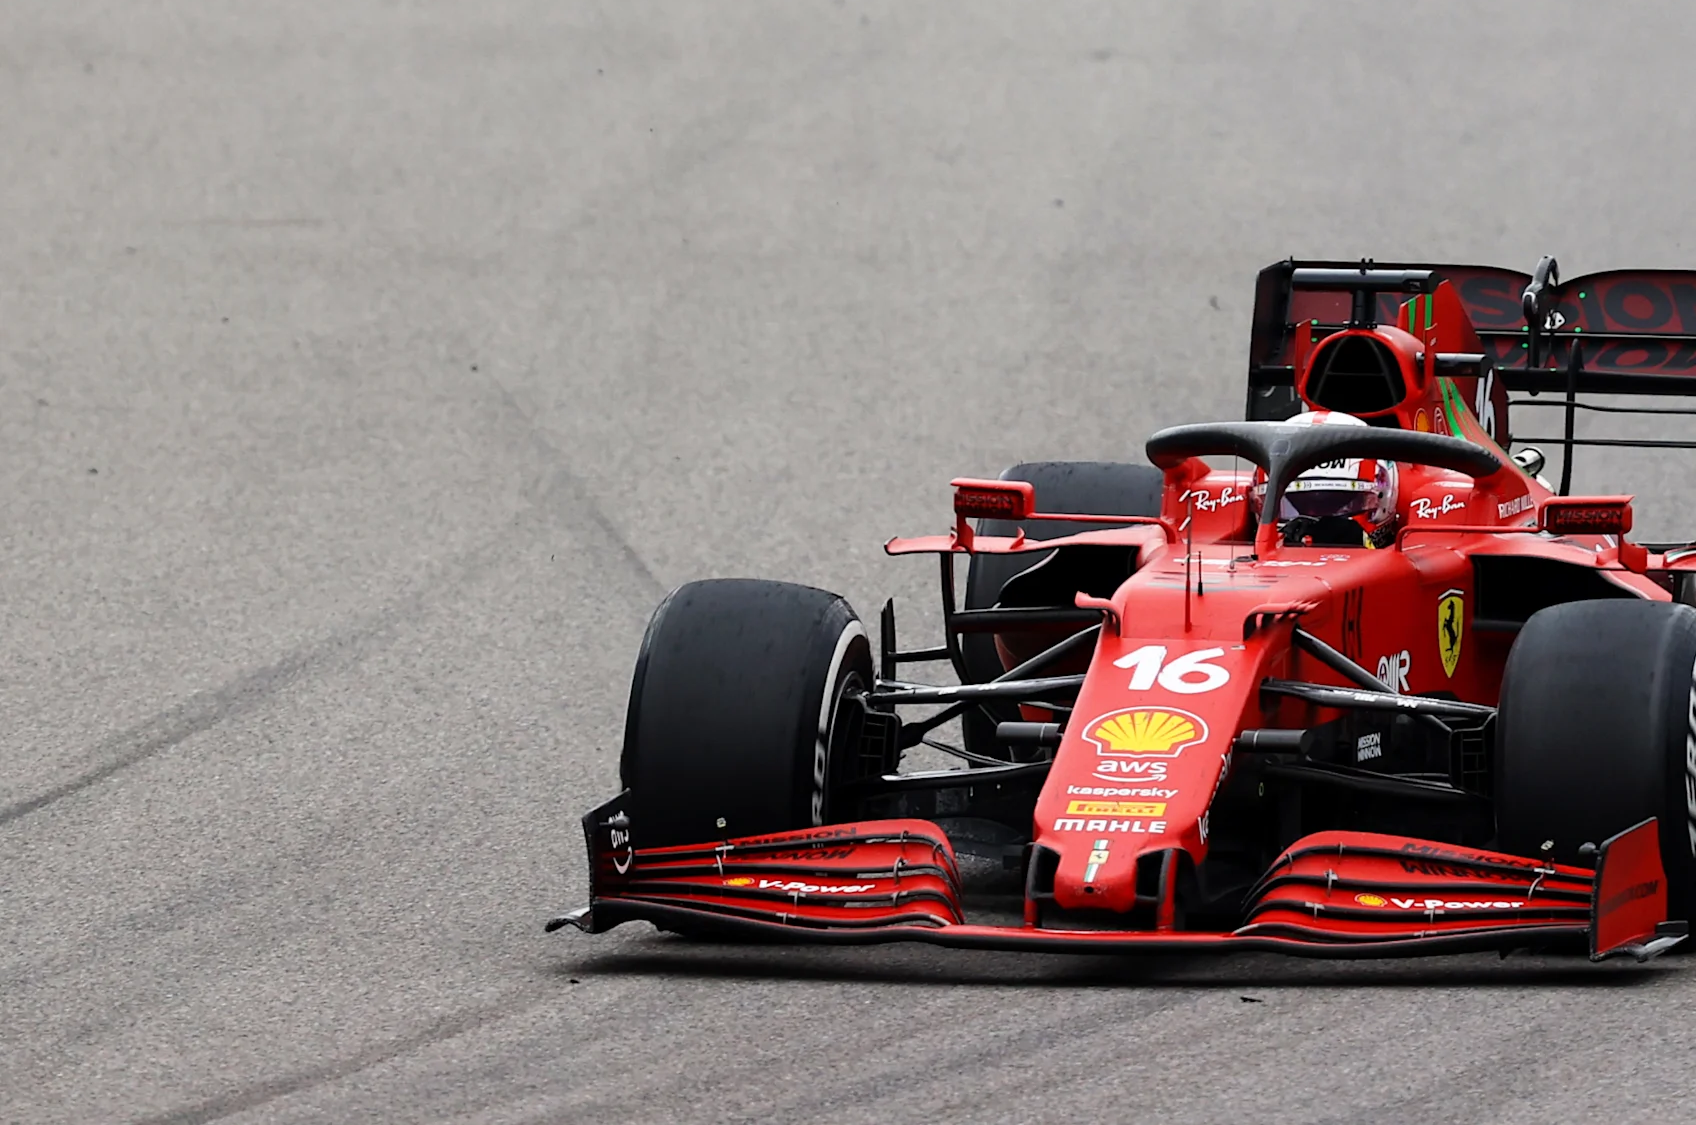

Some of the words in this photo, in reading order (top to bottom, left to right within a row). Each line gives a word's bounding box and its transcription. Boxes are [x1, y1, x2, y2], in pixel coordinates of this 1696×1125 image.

[1190, 487, 1245, 511] Ray-Ban
[1410, 494, 1466, 520] Ray-Ban
[1113, 645, 1230, 694] 16
[1096, 759, 1168, 774] aws
[1067, 785, 1179, 799] kaspersky
[1053, 818, 1167, 834] MAHLE
[757, 878, 876, 895] V-Power
[1389, 897, 1525, 910] V-Power
